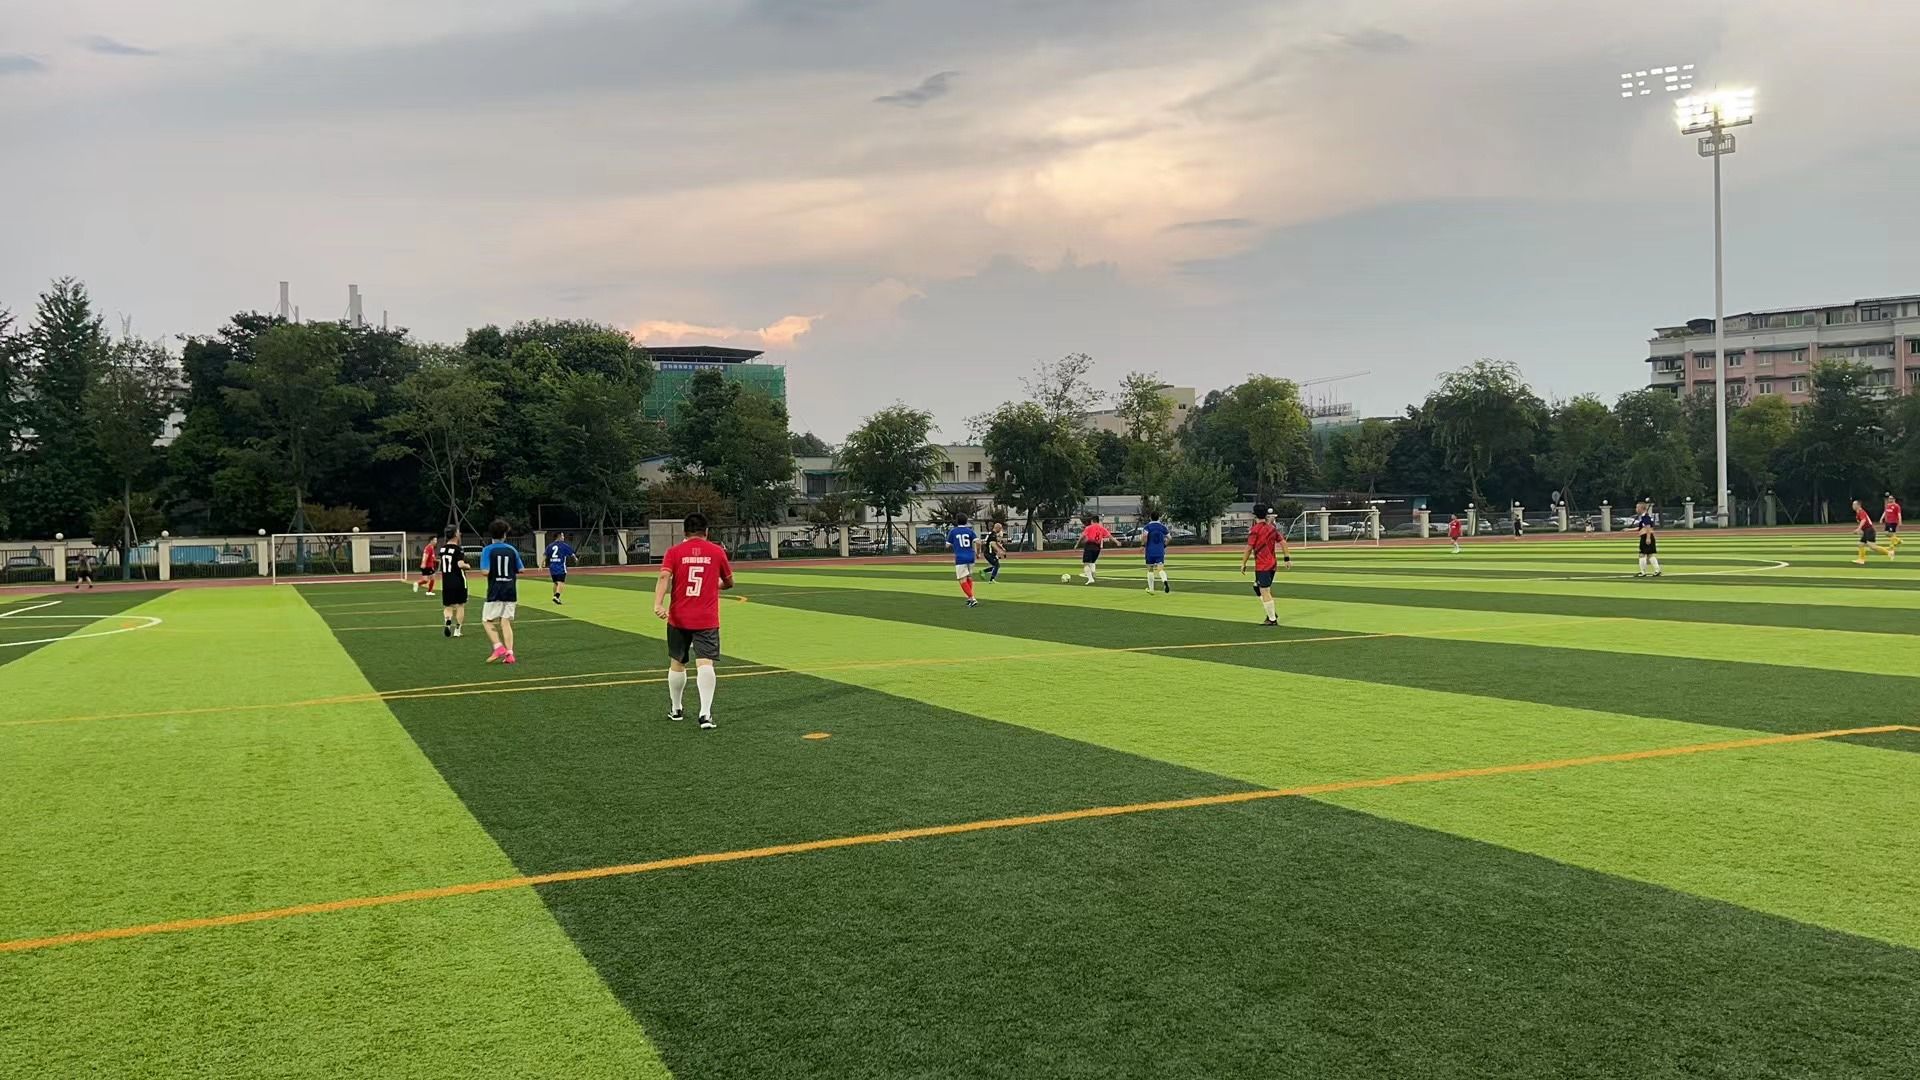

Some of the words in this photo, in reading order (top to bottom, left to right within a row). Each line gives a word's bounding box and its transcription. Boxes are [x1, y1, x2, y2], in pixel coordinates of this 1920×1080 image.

[956, 533, 970, 547] 16
[551, 545, 559, 558] 2
[441, 555, 452, 573] 17
[497, 555, 509, 577] 11
[686, 566, 704, 597] 5
